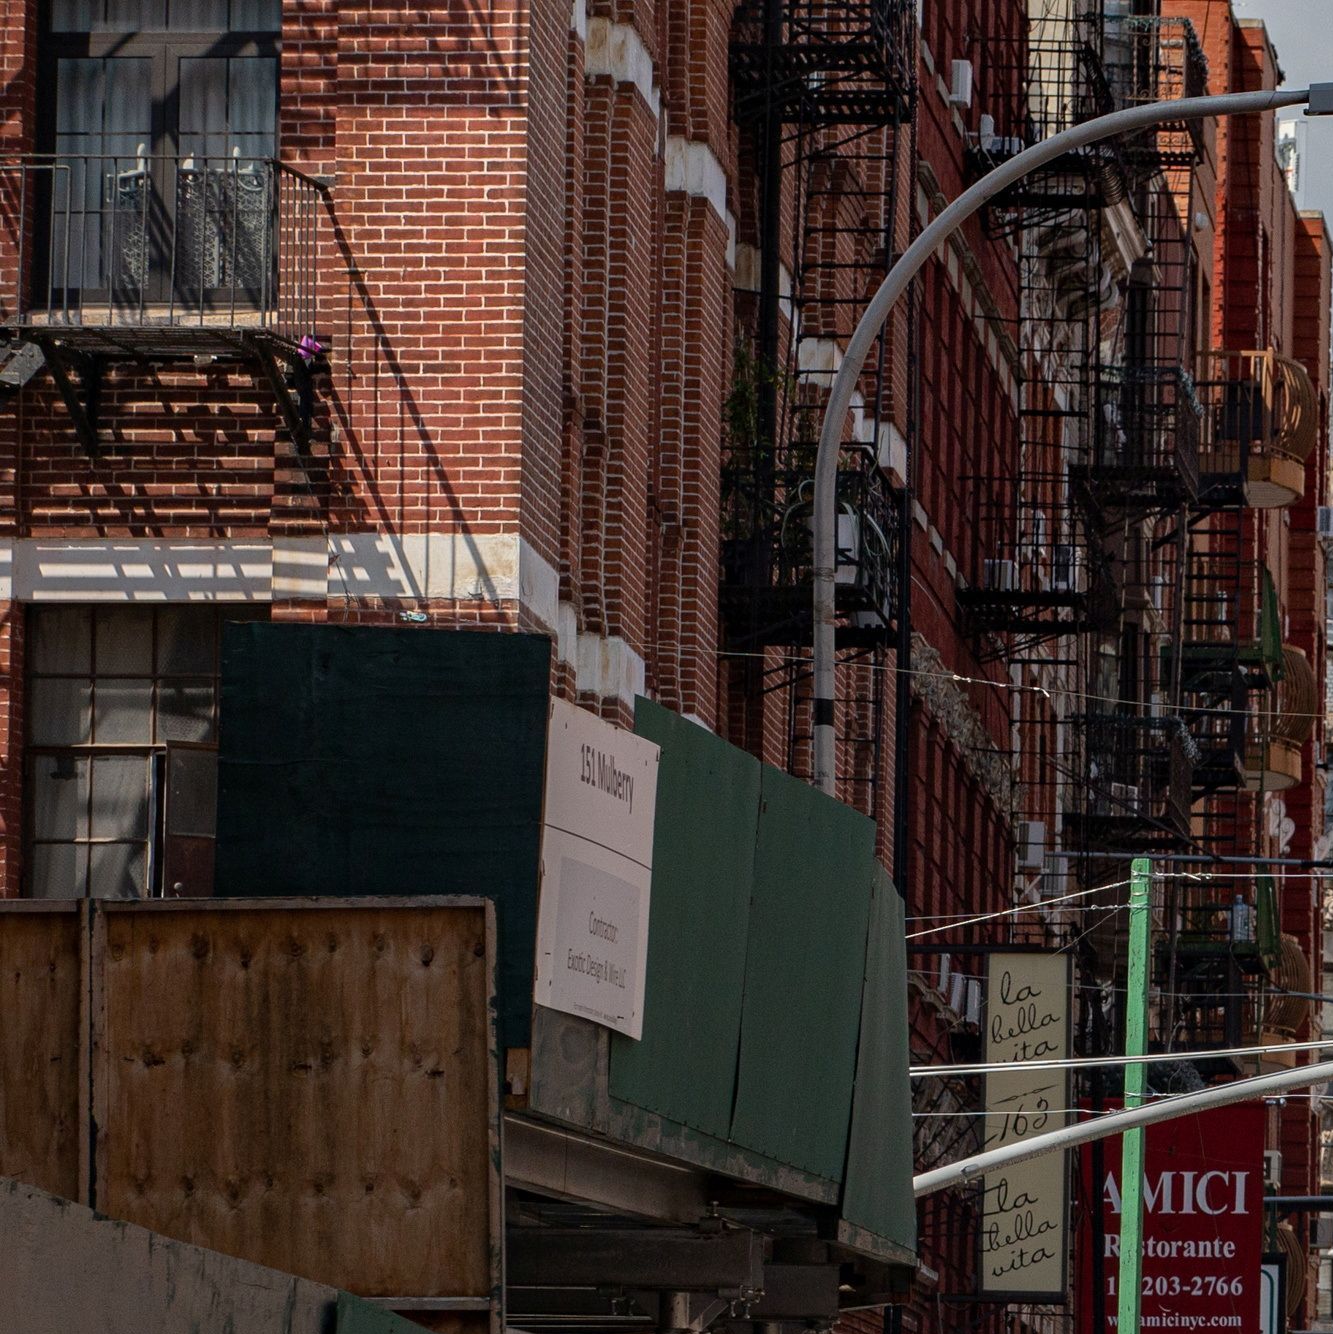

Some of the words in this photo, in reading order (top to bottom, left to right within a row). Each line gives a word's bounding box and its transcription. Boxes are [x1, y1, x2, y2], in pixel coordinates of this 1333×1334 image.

[581, 744, 595, 786] 151
[598, 751, 634, 814] Mulberry
[1001, 971, 1041, 1005] la
[992, 1003, 1060, 1044] bella
[996, 1041, 1058, 1063] ita
[1000, 1097, 1049, 1141] 163
[999, 1178, 1038, 1212] la
[989, 1210, 1058, 1251] bella
[1104, 1234, 1236, 1258] Rstorante
[992, 1248, 1055, 1277] vita
